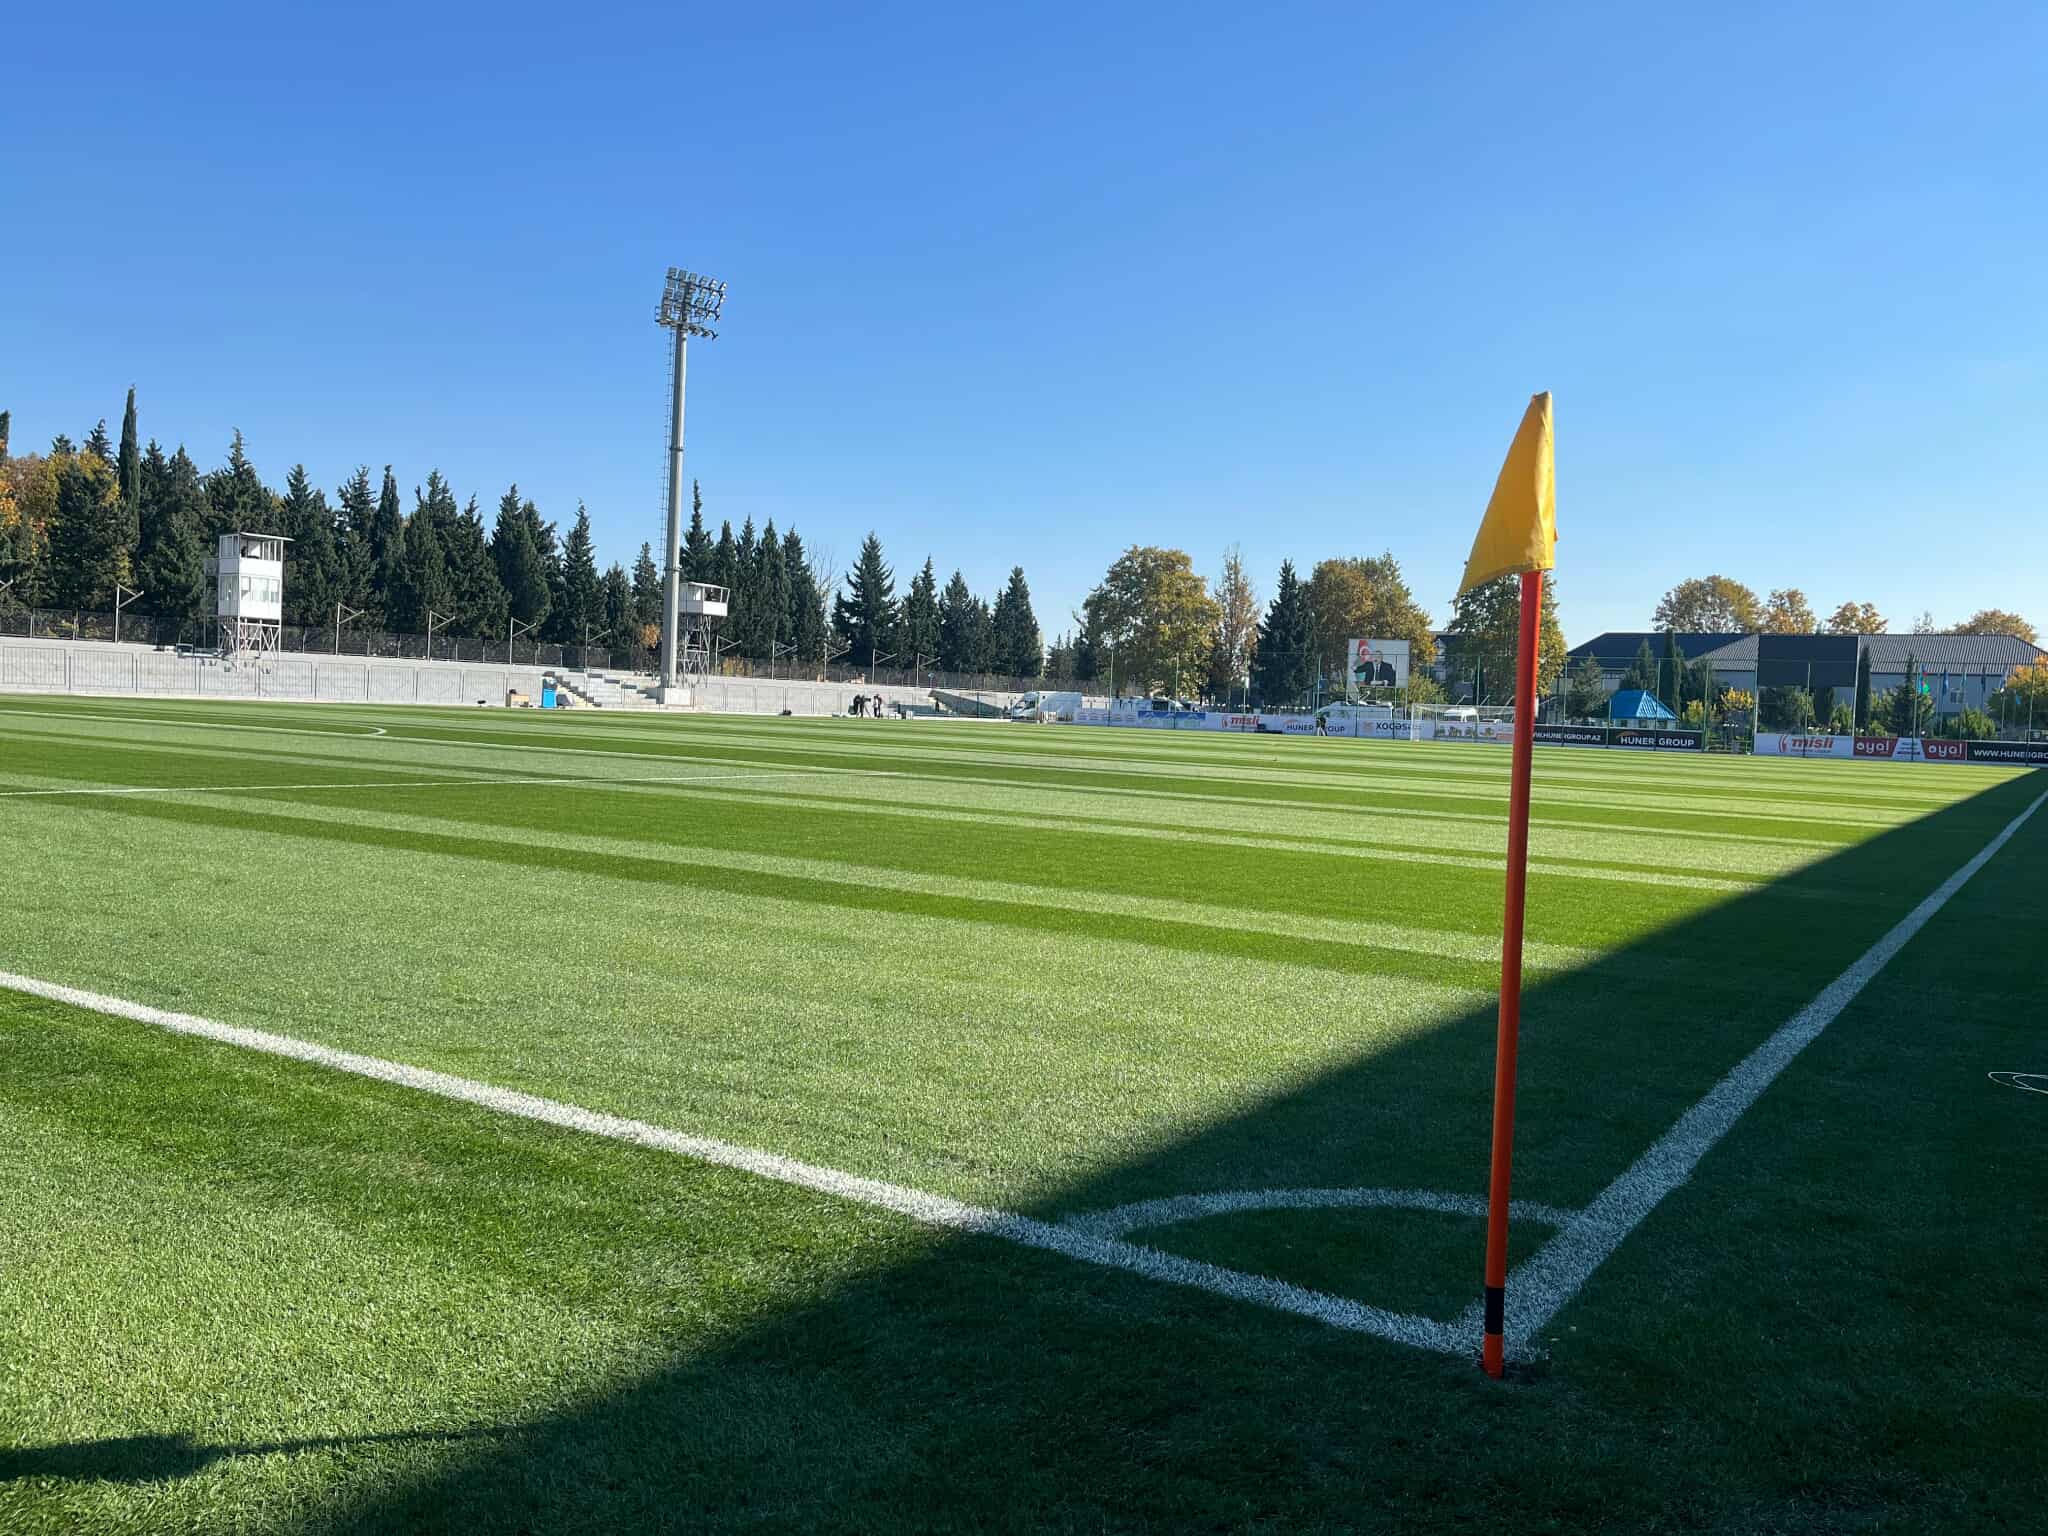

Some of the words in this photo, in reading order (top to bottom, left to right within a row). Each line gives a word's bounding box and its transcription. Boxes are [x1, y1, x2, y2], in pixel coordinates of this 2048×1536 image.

[1620, 735, 1655, 745] HUNER
[1658, 738, 1695, 747] GROUP
[1791, 736, 1834, 749] misli
